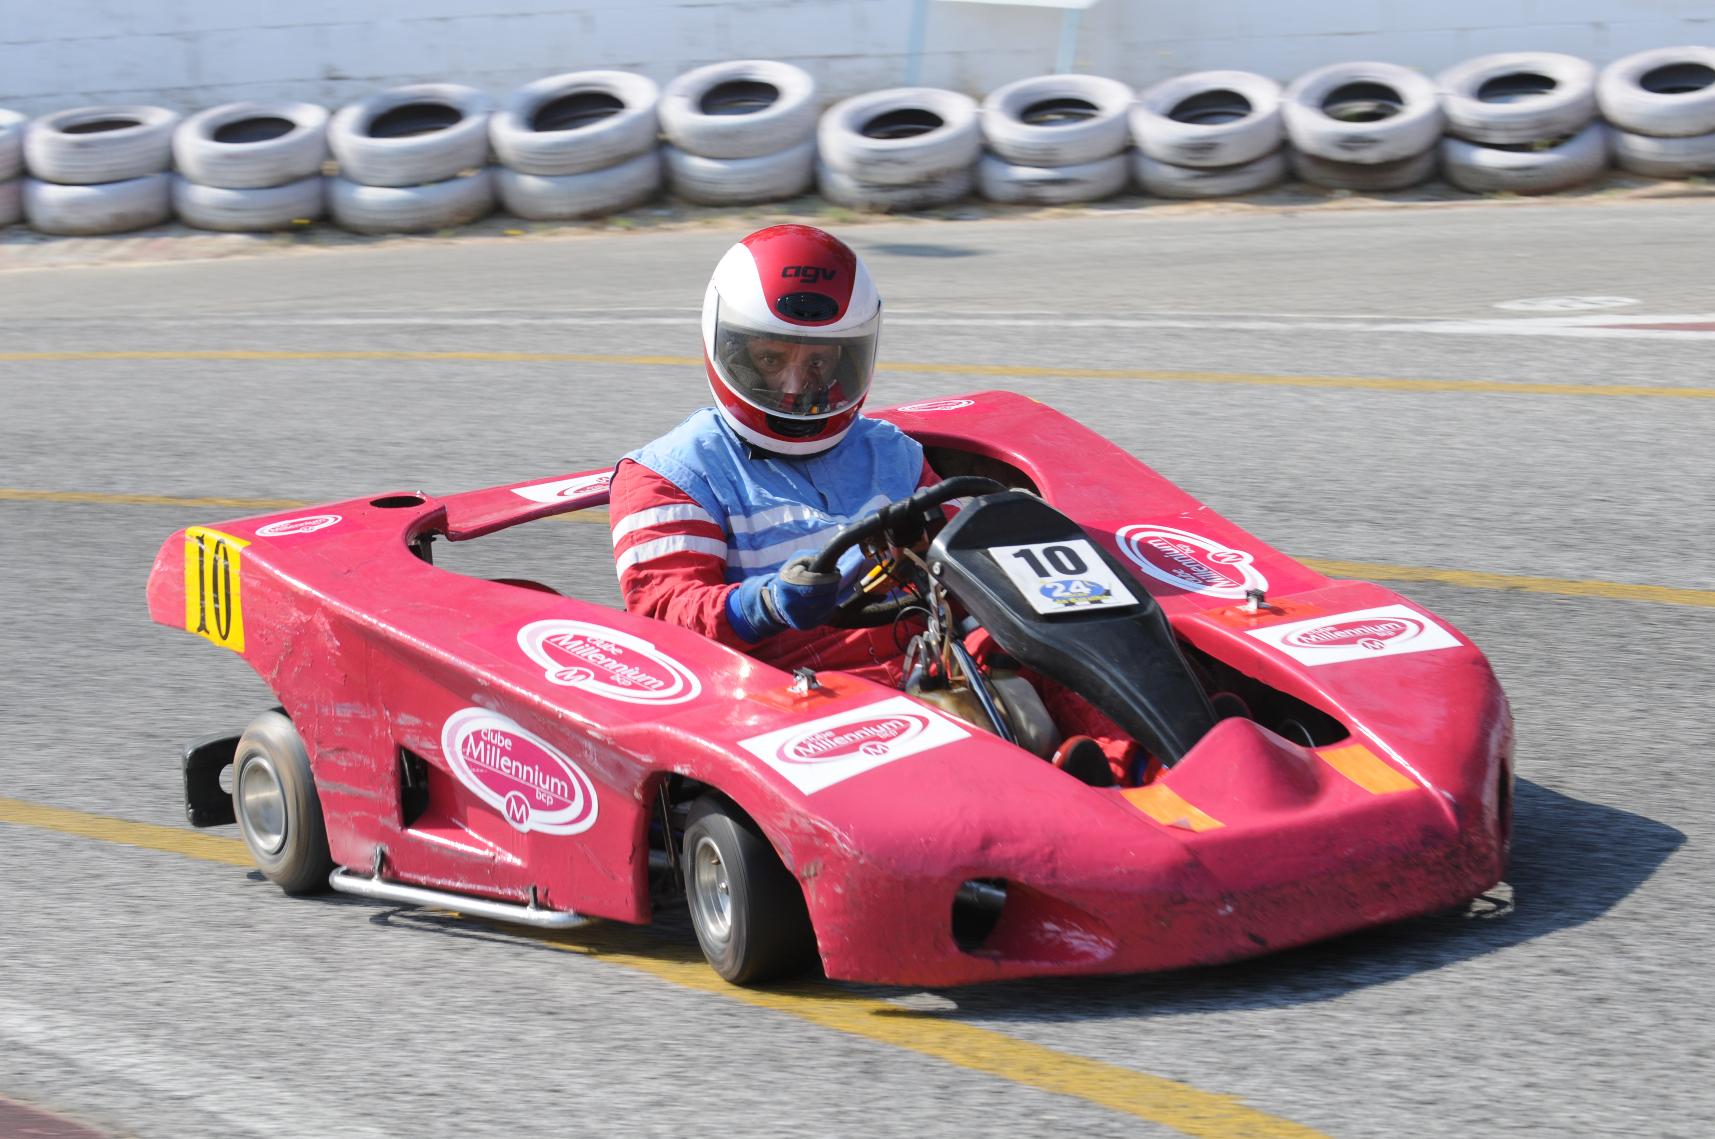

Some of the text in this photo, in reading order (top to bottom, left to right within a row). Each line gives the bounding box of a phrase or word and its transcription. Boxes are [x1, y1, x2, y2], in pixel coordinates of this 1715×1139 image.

[781, 266, 836, 284] agv
[1012, 545, 1088, 578] 10
[1147, 538, 1237, 588] Millennium
[196, 533, 231, 640] 10
[1045, 580, 1092, 597] 24
[1298, 621, 1402, 644] Millennium
[551, 633, 665, 689] Millennium
[481, 728, 512, 750] clube
[795, 719, 905, 758] Millennium
[466, 732, 568, 798] Millennium
[509, 796, 528, 824] M
[535, 788, 554, 807] bcp
